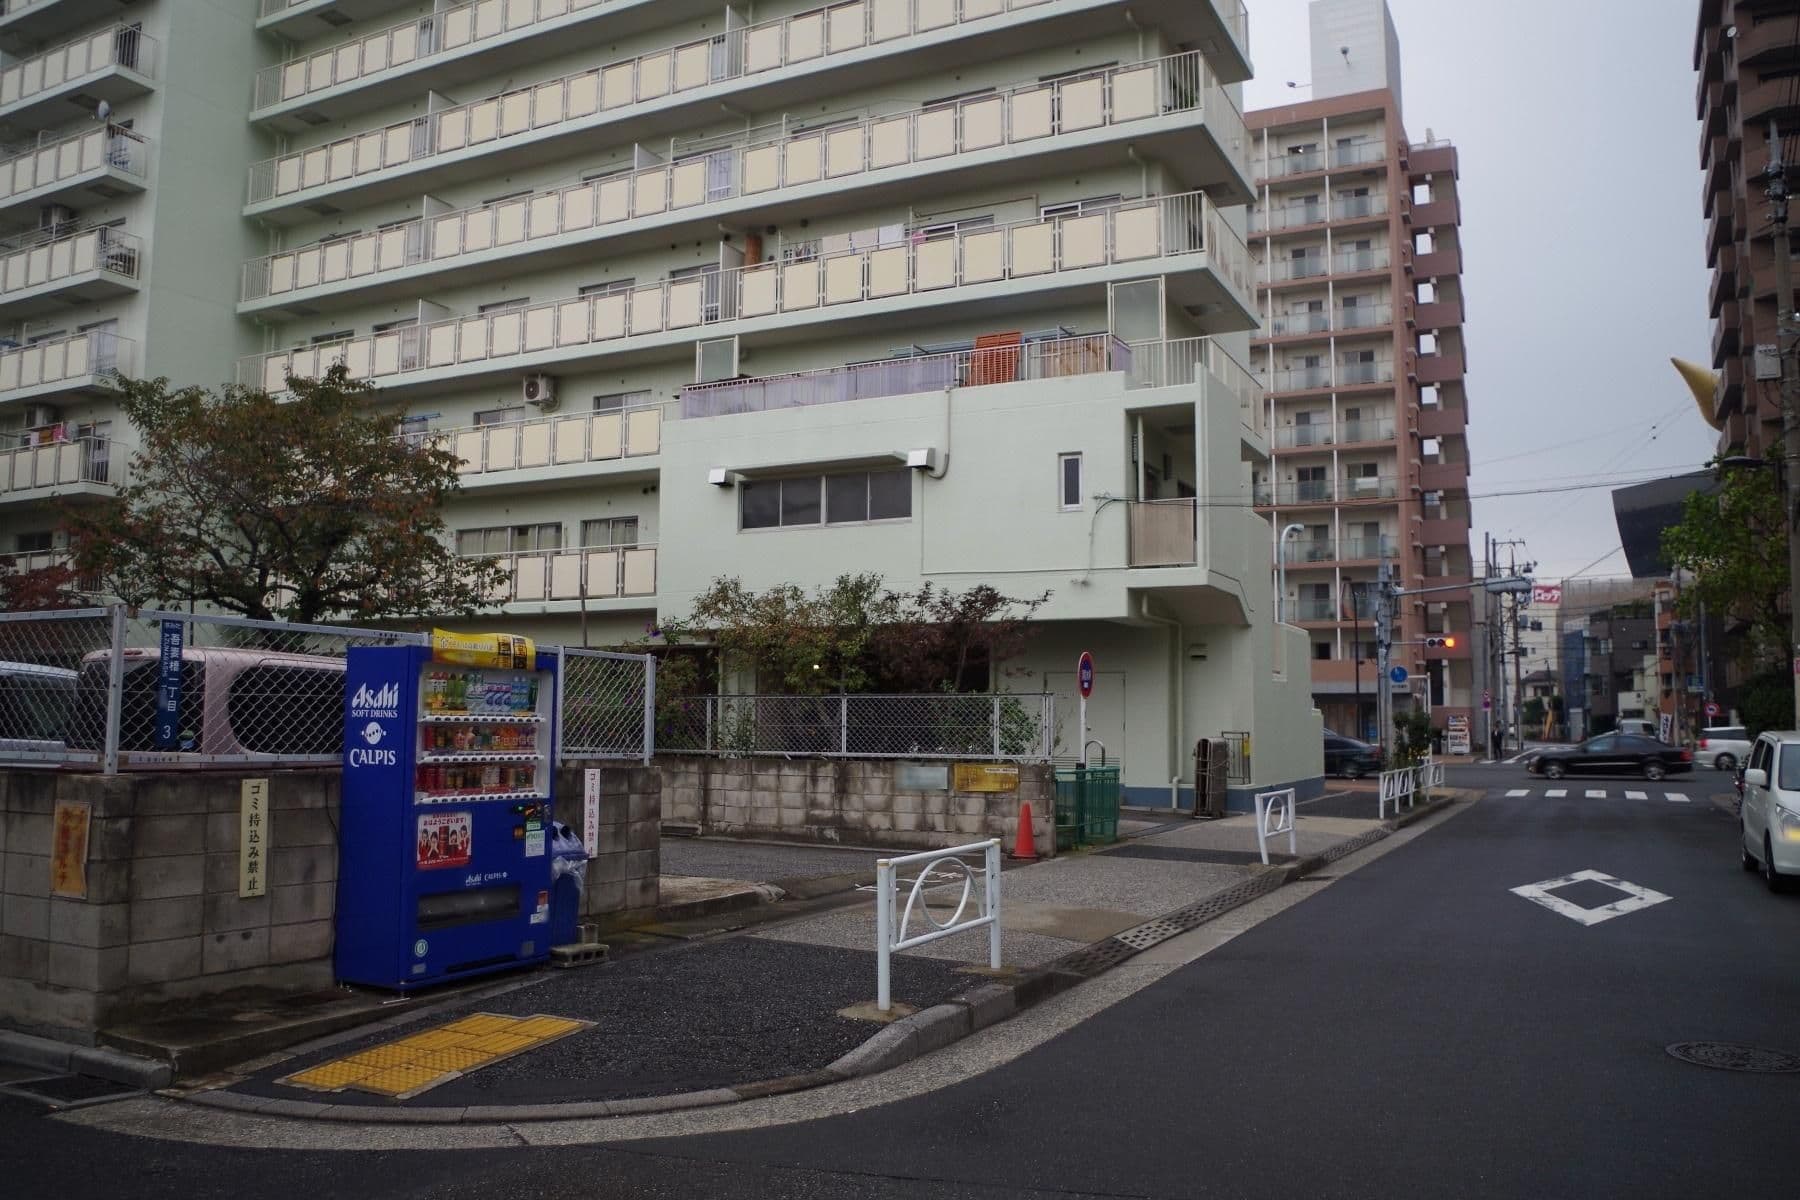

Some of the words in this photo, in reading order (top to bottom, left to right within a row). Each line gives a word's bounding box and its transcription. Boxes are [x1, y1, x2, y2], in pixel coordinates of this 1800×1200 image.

[1534, 588, 1561, 602] ロッテ
[351, 681, 399, 709] Asahi
[351, 709, 369, 718] SOFT
[370, 709, 398, 718] DRINKS
[162, 725, 171, 739] 3
[349, 748, 396, 768] CALPIS
